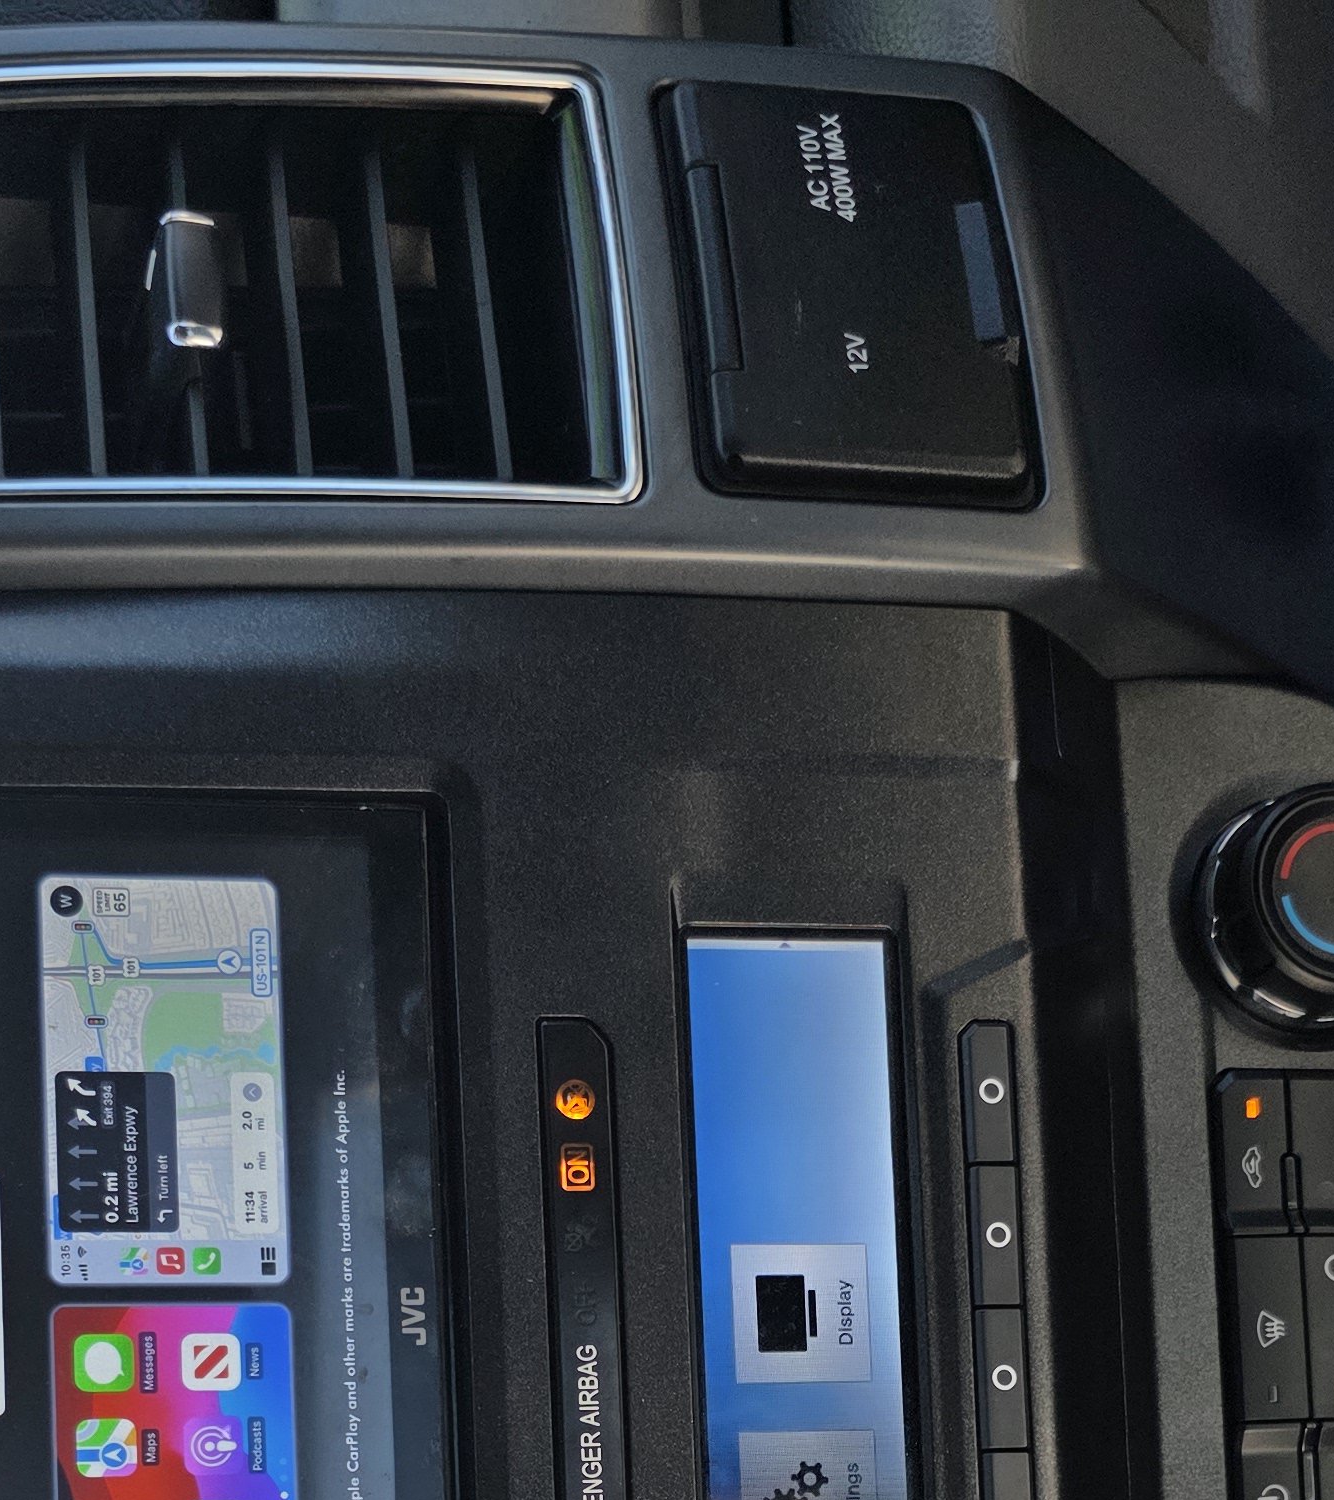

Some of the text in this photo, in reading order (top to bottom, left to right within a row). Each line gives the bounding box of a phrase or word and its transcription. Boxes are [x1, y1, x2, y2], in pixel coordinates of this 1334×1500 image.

[796, 124, 831, 211] AC 110V
[819, 113, 858, 222] 400W MAX
[844, 331, 869, 374] 12V
[61, 894, 73, 908] W
[96, 890, 104, 914] SPEED
[113, 892, 127, 912] 65
[92, 968, 102, 983] 101
[127, 960, 136, 975] 101
[253, 935, 267, 992] US-101 N
[333, 1069, 346, 1096] Inc.
[103, 1084, 115, 1126] Exit 394
[241, 1110, 253, 1130] 2.0
[334, 1100, 351, 1144] Apple
[255, 1118, 265, 1130] mi
[123, 1106, 139, 1224] Lawrence Expwy
[243, 1162, 254, 1170] 5
[257, 1151, 267, 1170] min
[335, 1148, 349, 1164] of
[567, 1149, 590, 1184] ON
[157, 1154, 169, 1200] Turn left
[103, 1172, 119, 1224] 0.2 mi
[245, 1190, 255, 1224] 11:34
[257, 1190, 269, 1224] arrival
[337, 1168, 352, 1252] trademarks
[61, 1245, 71, 1277] 10:35
[341, 1257, 353, 1282] are
[341, 1287, 355, 1332] marks
[400, 1287, 427, 1346] JVC
[837, 1280, 855, 1345] Display
[141, 1335, 157, 1391] Messages
[247, 1346, 261, 1377] News
[343, 1336, 357, 1376] other
[343, 1381, 357, 1410] and
[576, 1344, 601, 1426] AIRBAG
[145, 1432, 160, 1463] Maps
[250, 1420, 264, 1471] Podcasts
[345, 1414, 361, 1472] CarPlay
